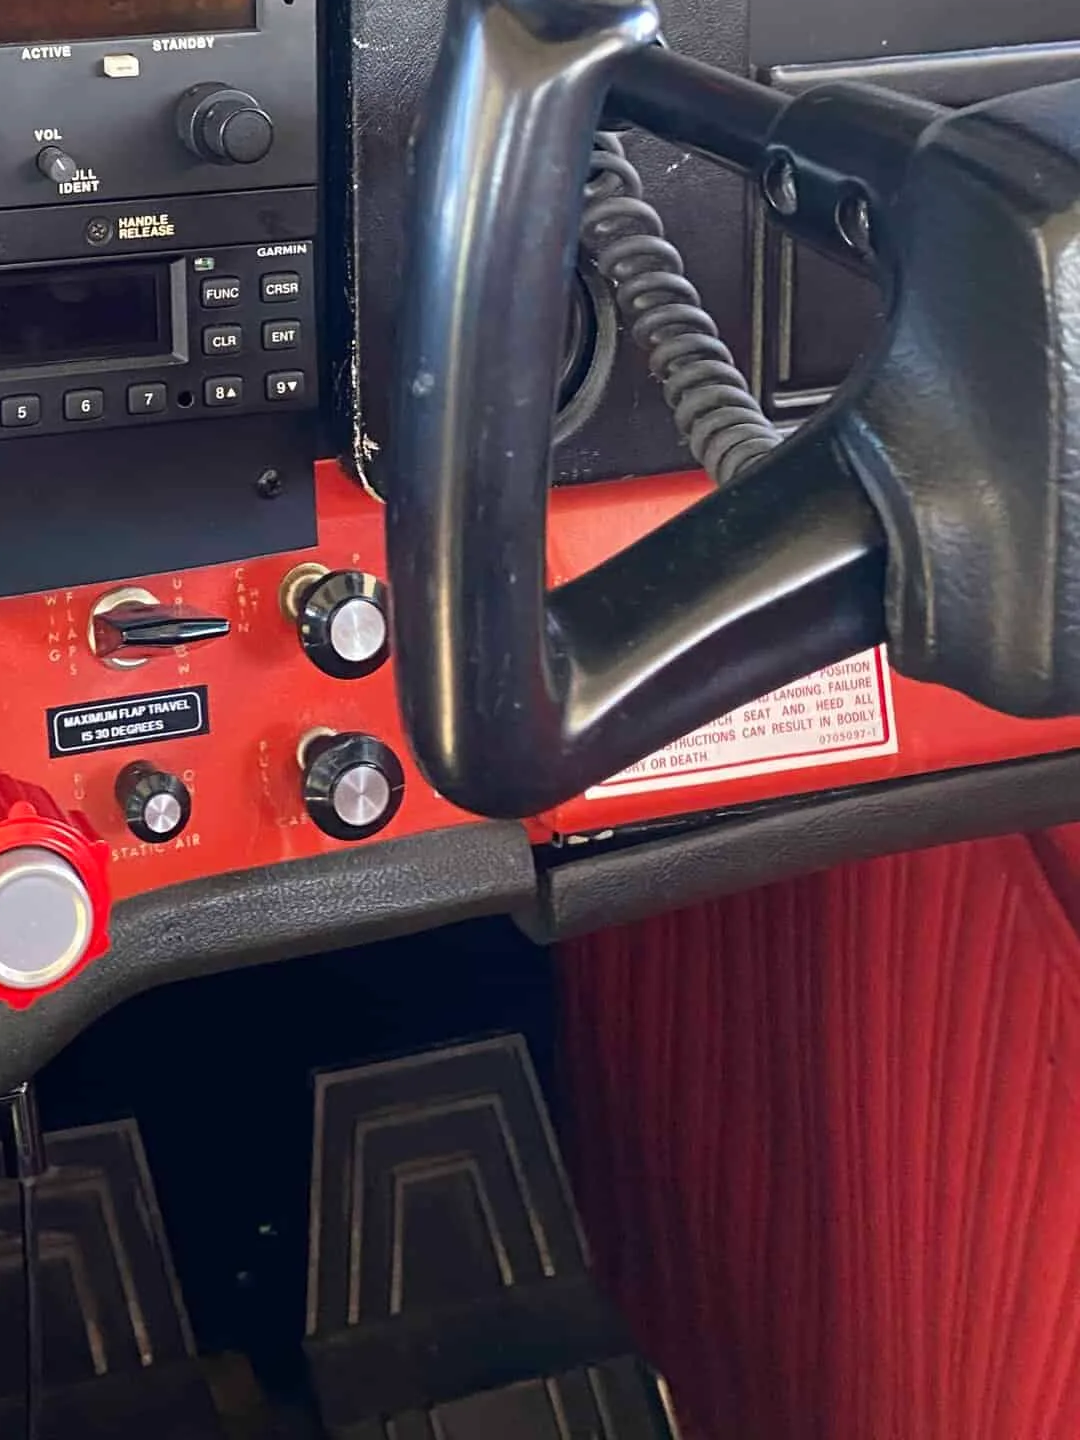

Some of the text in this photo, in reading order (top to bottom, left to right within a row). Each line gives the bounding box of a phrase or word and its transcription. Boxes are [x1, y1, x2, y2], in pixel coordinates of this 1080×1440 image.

[152, 37, 215, 52] STANDBY
[21, 46, 72, 59] ACTIVE
[59, 181, 100, 195] IDENT
[119, 215, 169, 229] HANDLE
[119, 224, 175, 240] RELEASE
[257, 244, 307, 257] GARMIN
[206, 287, 239, 301] FUNC
[265, 283, 299, 296] CRSR
[213, 335, 236, 347] CLR
[272, 330, 295, 343] ENT
[144, 393, 153, 405] 7
[17, 406, 27, 418] 5
[63, 699, 191, 728] MAXIMUM FLAP TRAVEL
[81, 720, 164, 742] IS 30 DEGREES
[650, 750, 708, 770] OR DEATH
